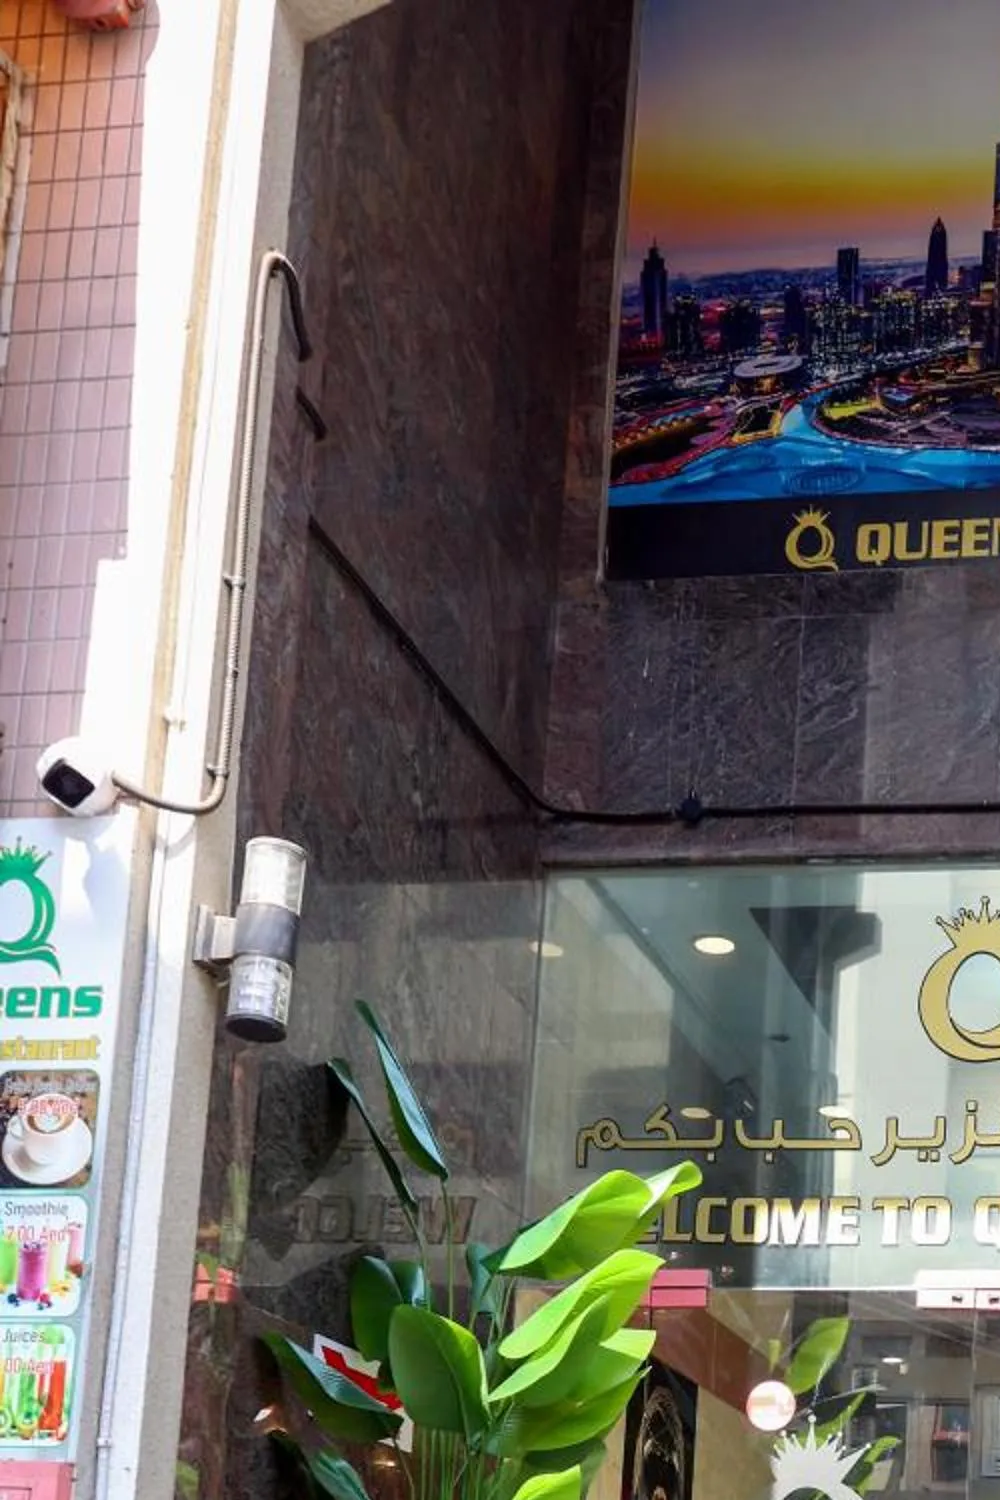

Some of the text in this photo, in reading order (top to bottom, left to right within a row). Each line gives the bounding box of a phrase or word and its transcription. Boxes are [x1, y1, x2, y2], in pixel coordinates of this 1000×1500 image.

[0, 984, 103, 1018] ens
[574, 1103, 724, 1168] بكم
[634, 1195, 861, 1246] LCOME
[871, 1195, 954, 1247] TO
